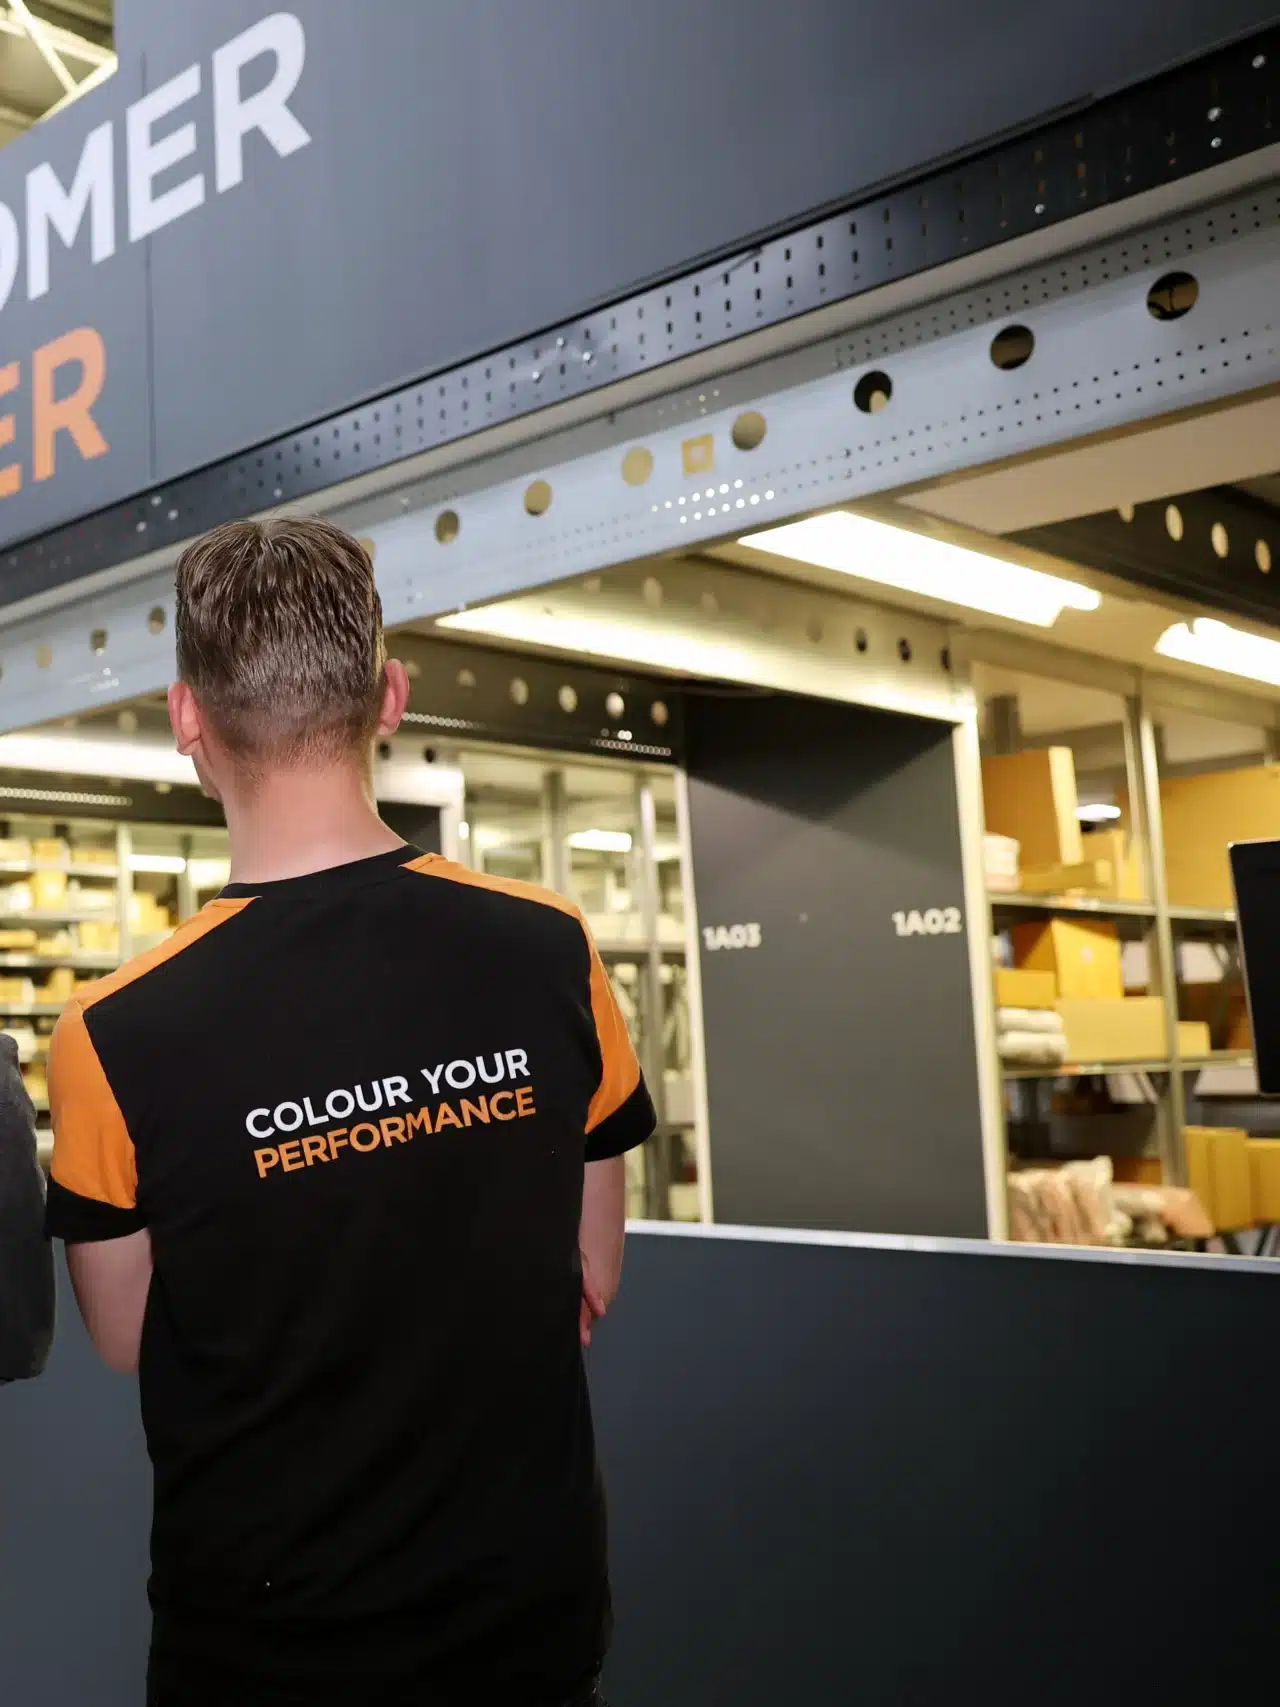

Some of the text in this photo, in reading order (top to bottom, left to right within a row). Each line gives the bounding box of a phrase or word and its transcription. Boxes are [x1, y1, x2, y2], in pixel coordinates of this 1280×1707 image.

[892, 907, 962, 936] 1A02
[245, 1048, 531, 1138] COLOUR YOUR
[254, 1086, 537, 1178] PERFORMANCE
